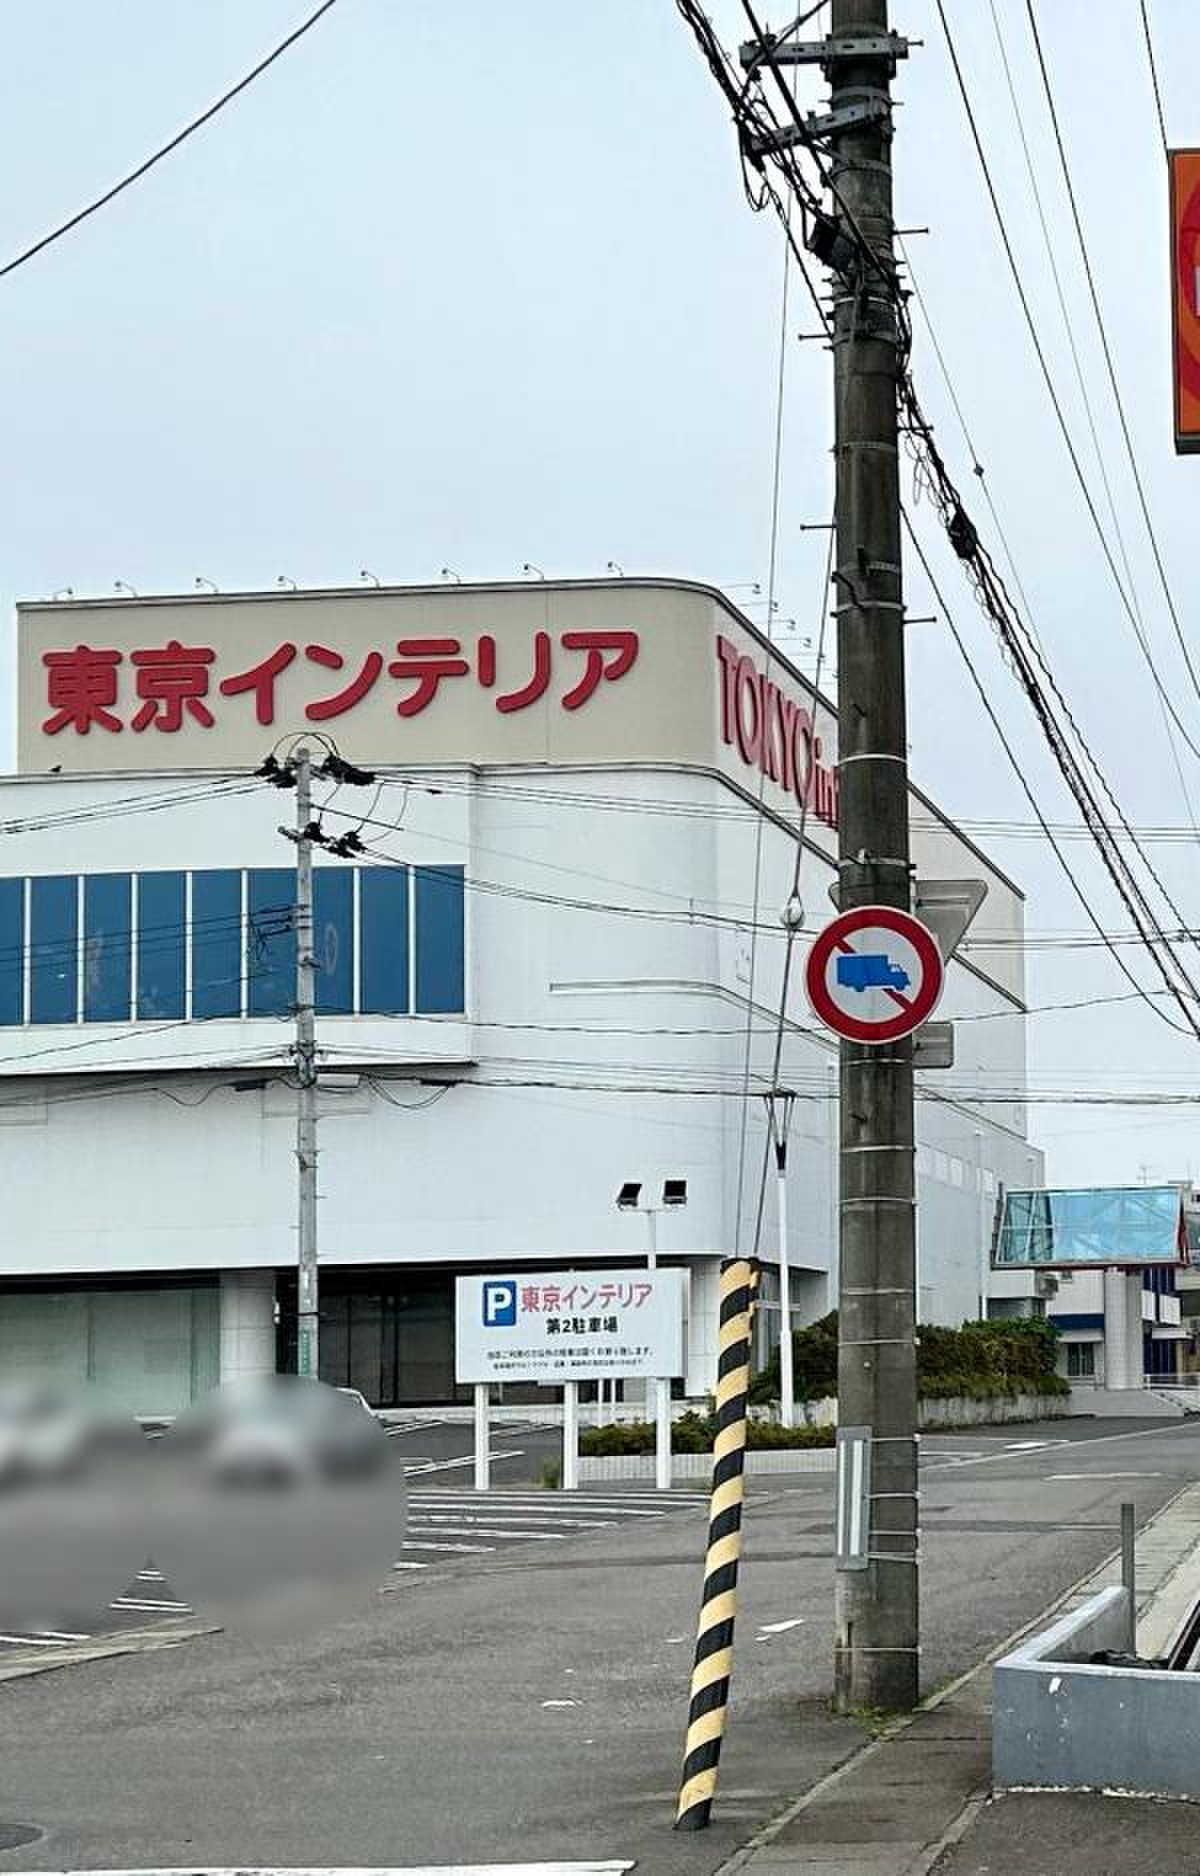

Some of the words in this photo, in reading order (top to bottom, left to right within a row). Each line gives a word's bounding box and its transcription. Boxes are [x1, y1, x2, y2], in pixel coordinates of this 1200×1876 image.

[42, 631, 639, 735] 東京インテリア
[486, 1287, 512, 1321] P
[521, 1282, 653, 1313] 東京インテリア
[546, 1316, 618, 1335] 第2駐車場
